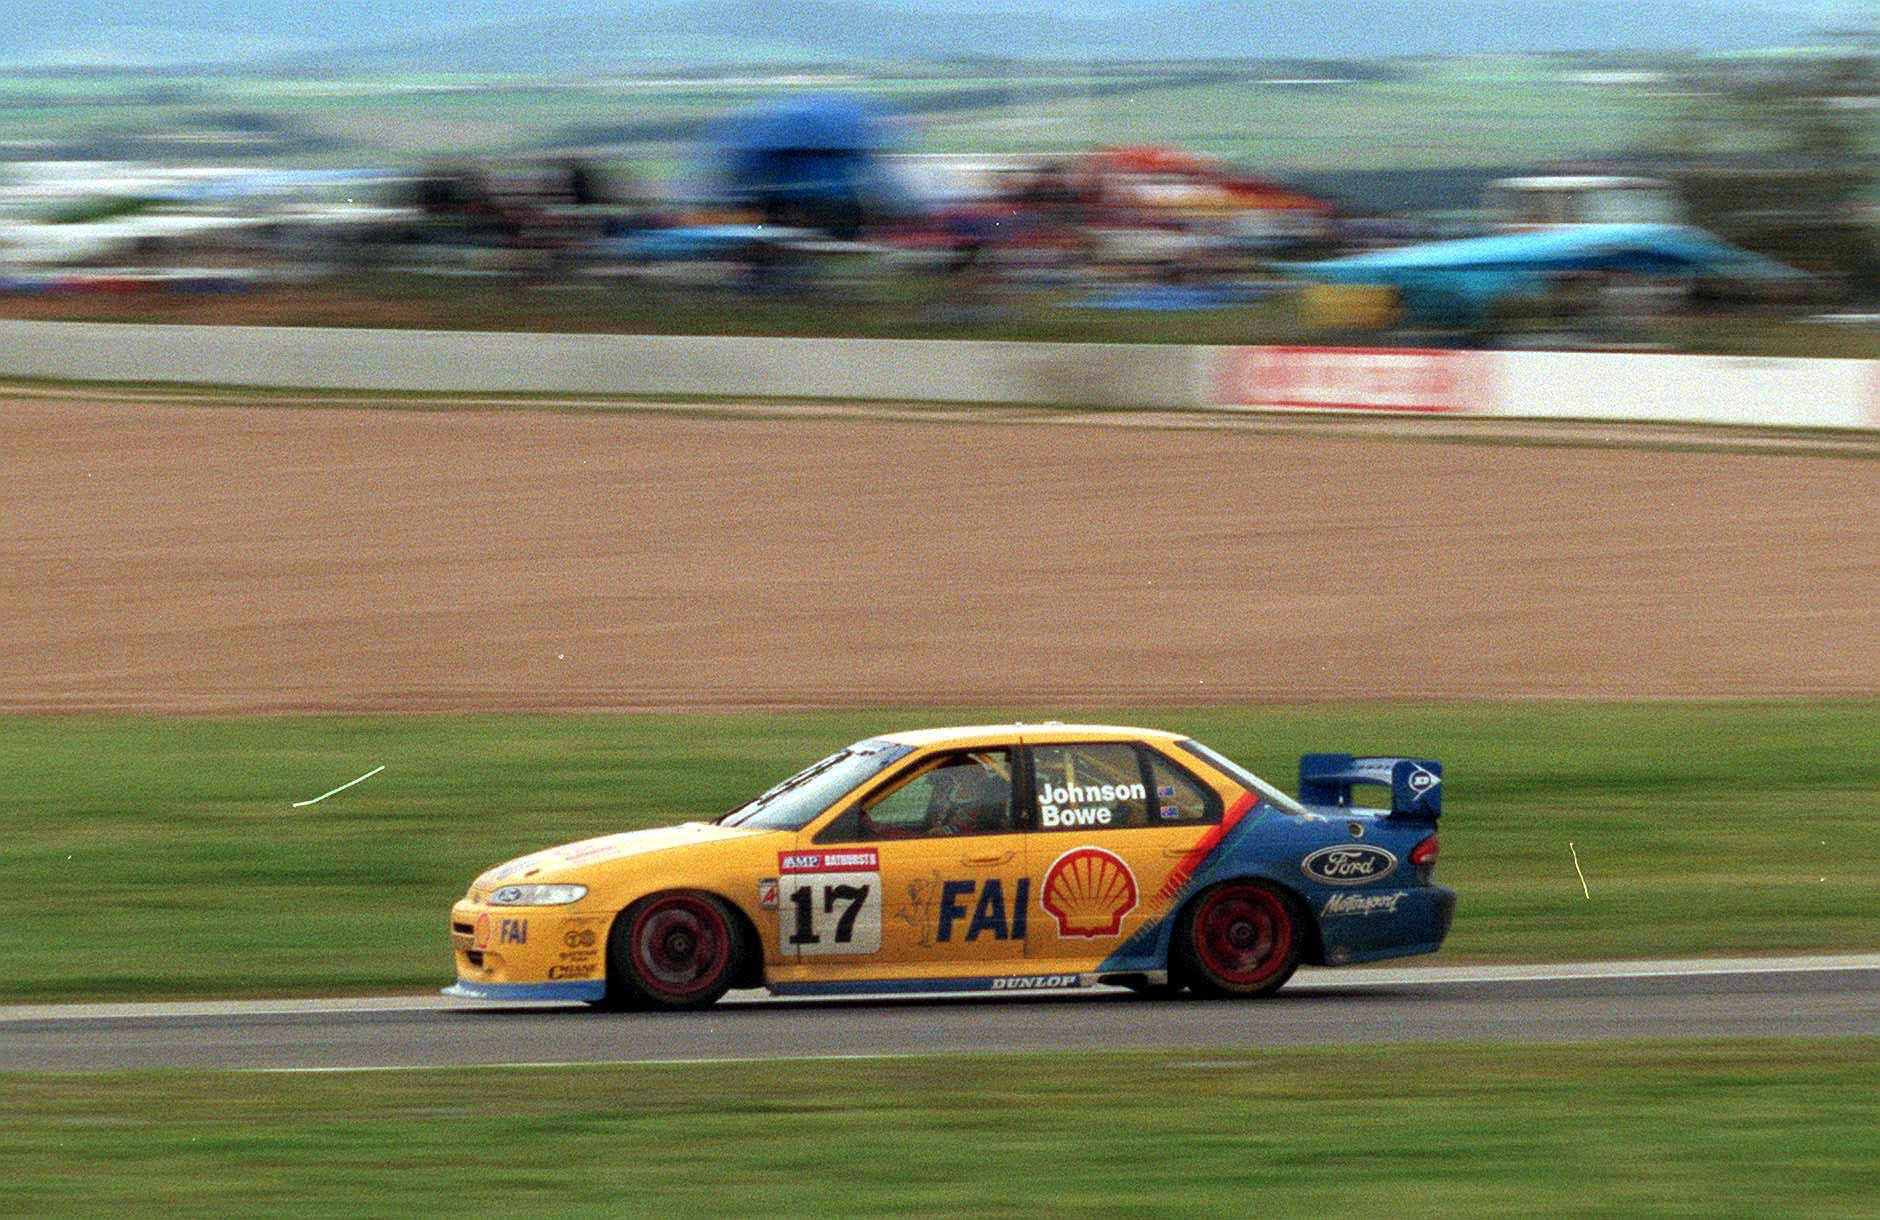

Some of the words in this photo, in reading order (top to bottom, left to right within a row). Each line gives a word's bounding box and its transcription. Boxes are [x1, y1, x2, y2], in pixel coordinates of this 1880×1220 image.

[1038, 783, 1146, 804] Johnson
[1041, 804, 1112, 826] Bowe
[1324, 851, 1376, 875] Ford
[789, 884, 870, 944] 17
[936, 878, 1030, 942] FAI
[501, 918, 528, 944] FAI
[991, 976, 1077, 990] DUNLOP
